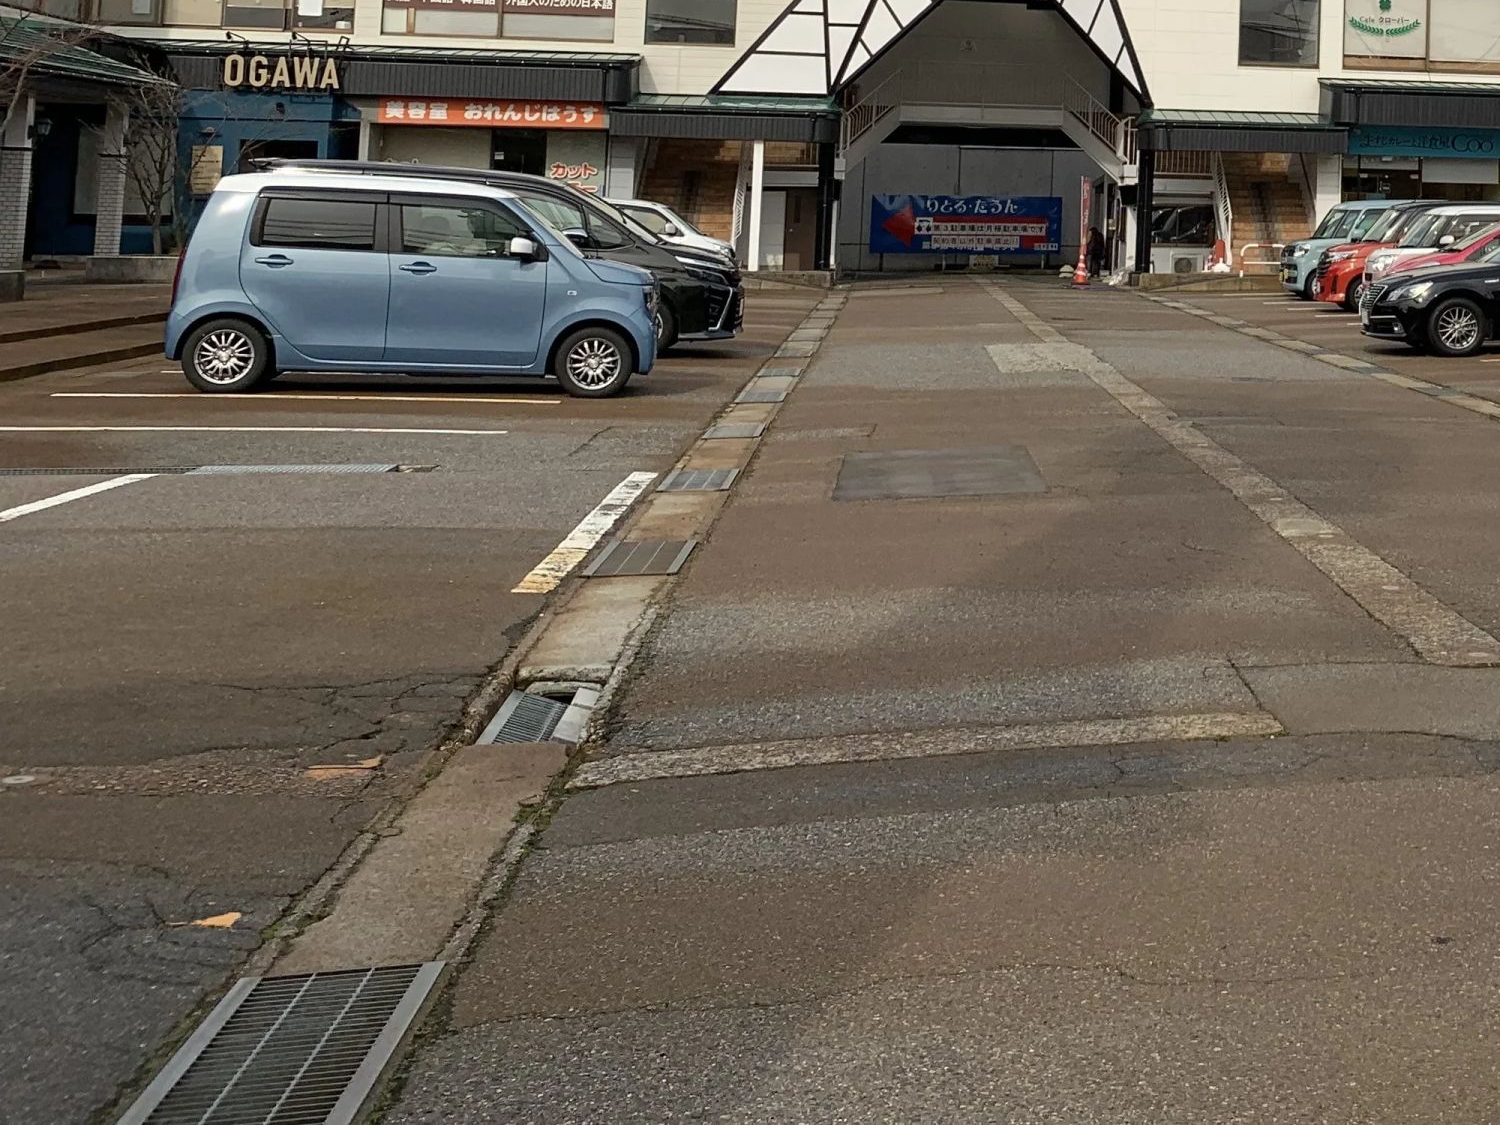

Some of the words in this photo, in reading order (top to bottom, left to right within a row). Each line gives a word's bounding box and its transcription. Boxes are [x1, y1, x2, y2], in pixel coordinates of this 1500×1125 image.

[1359, 16, 1375, 24] Cafe
[1378, 16, 1410, 24] クローバー
[223, 53, 340, 89] OGAWA
[385, 101, 449, 121] 美容室
[464, 103, 599, 123] おれんじはうす
[550, 161, 598, 179] カット
